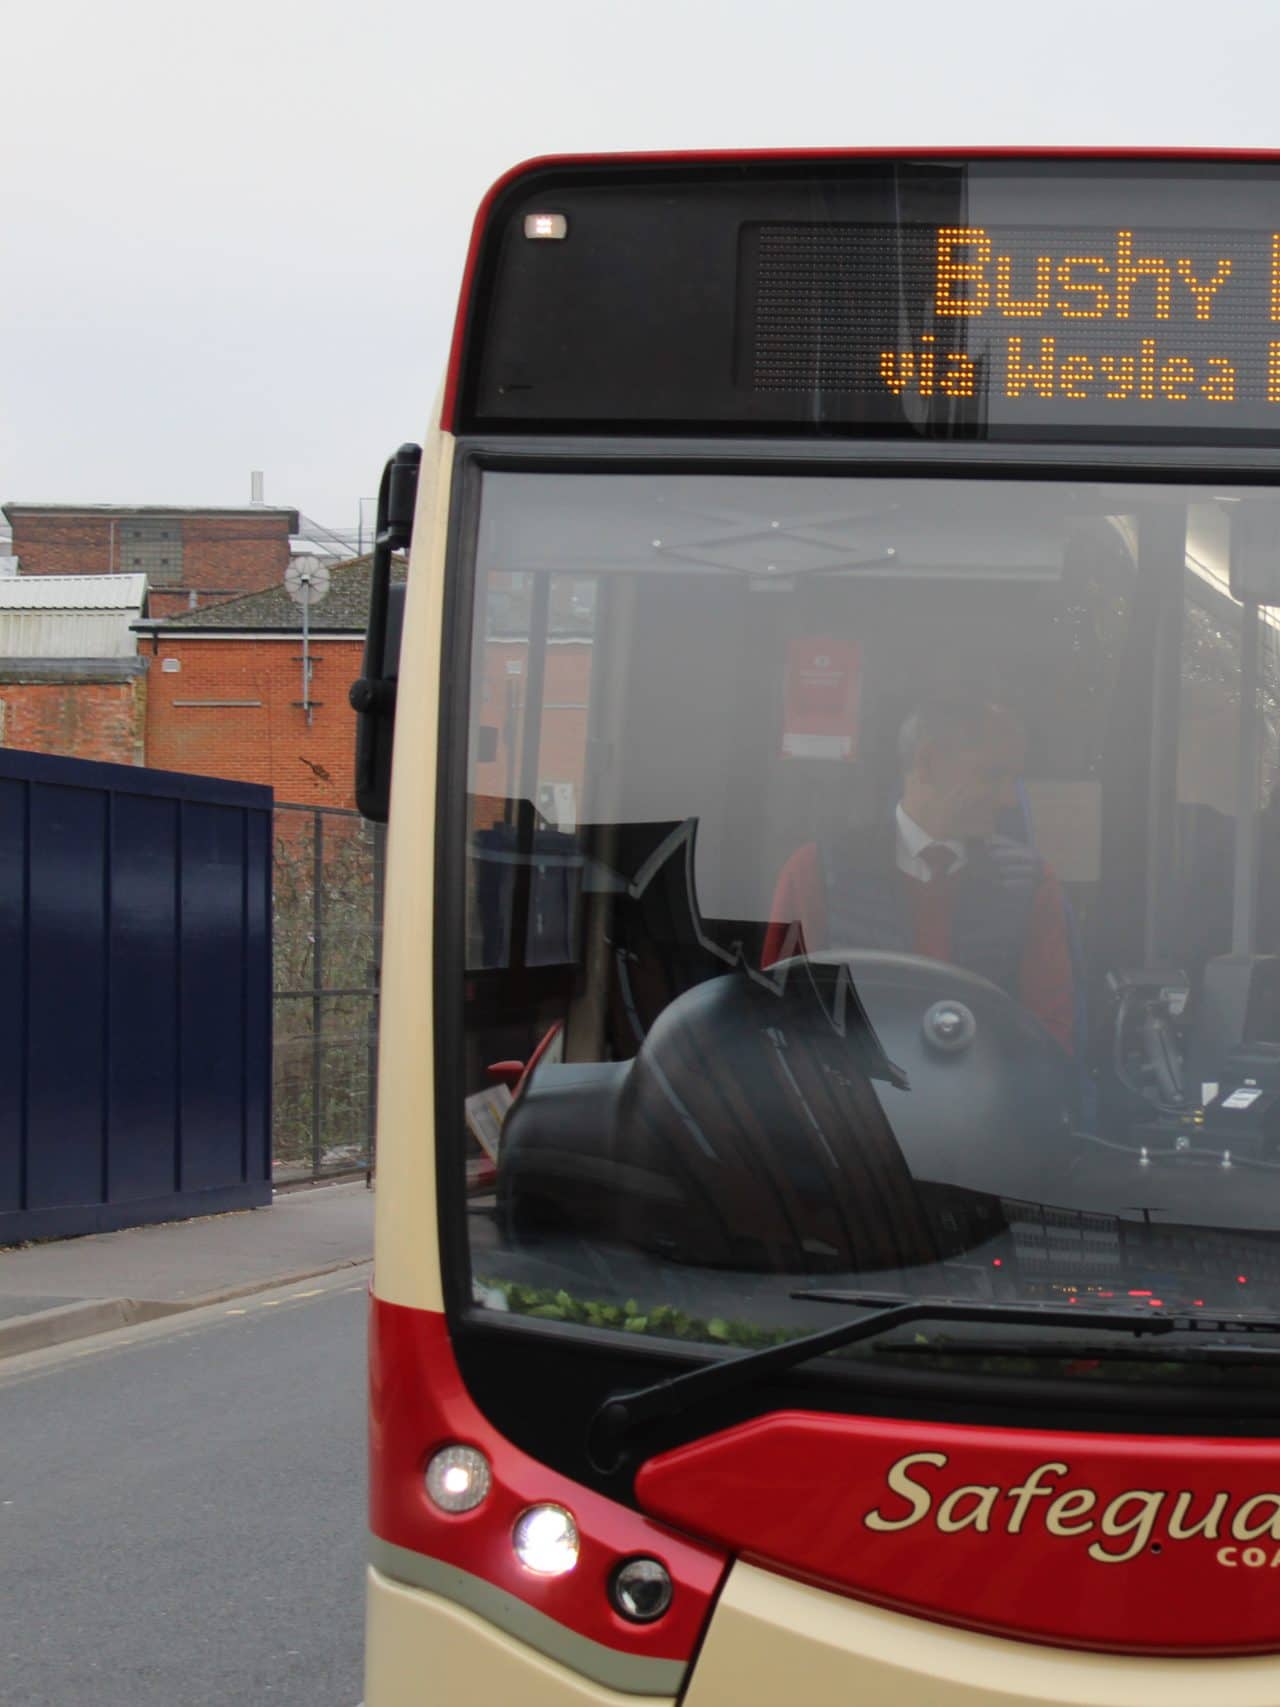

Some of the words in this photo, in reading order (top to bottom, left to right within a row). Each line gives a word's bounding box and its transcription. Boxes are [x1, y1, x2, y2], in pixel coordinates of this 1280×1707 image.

[935, 228, 1232, 320] Bushy
[880, 335, 974, 397] via
[1007, 337, 1235, 402] Weylea
